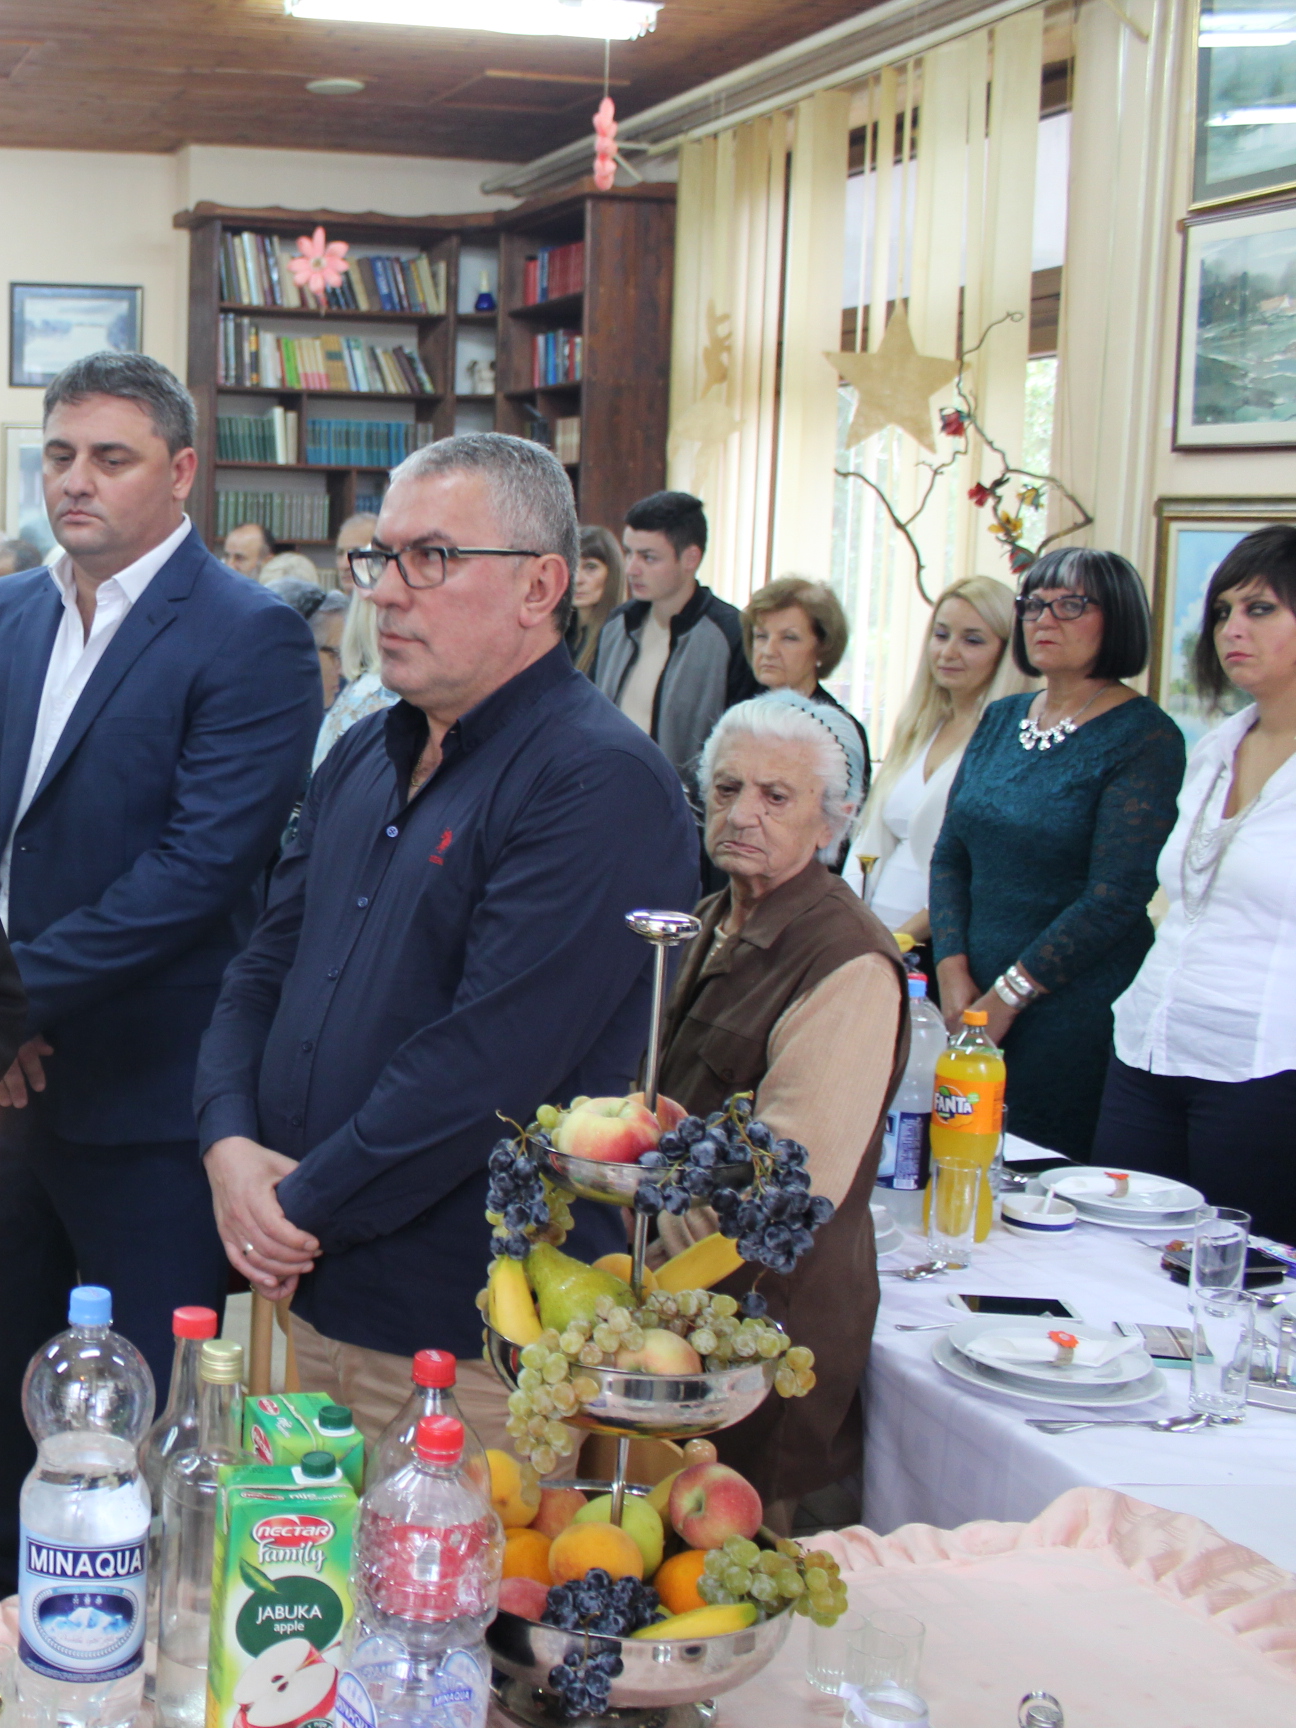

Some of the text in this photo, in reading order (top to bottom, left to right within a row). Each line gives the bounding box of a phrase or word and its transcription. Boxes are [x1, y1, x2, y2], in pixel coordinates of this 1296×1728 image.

[935, 1093, 972, 1113] FANTA
[30, 1545, 142, 1577] MINAQUA
[256, 1605, 322, 1624] JABUKA
[273, 1622, 304, 1634] apple
